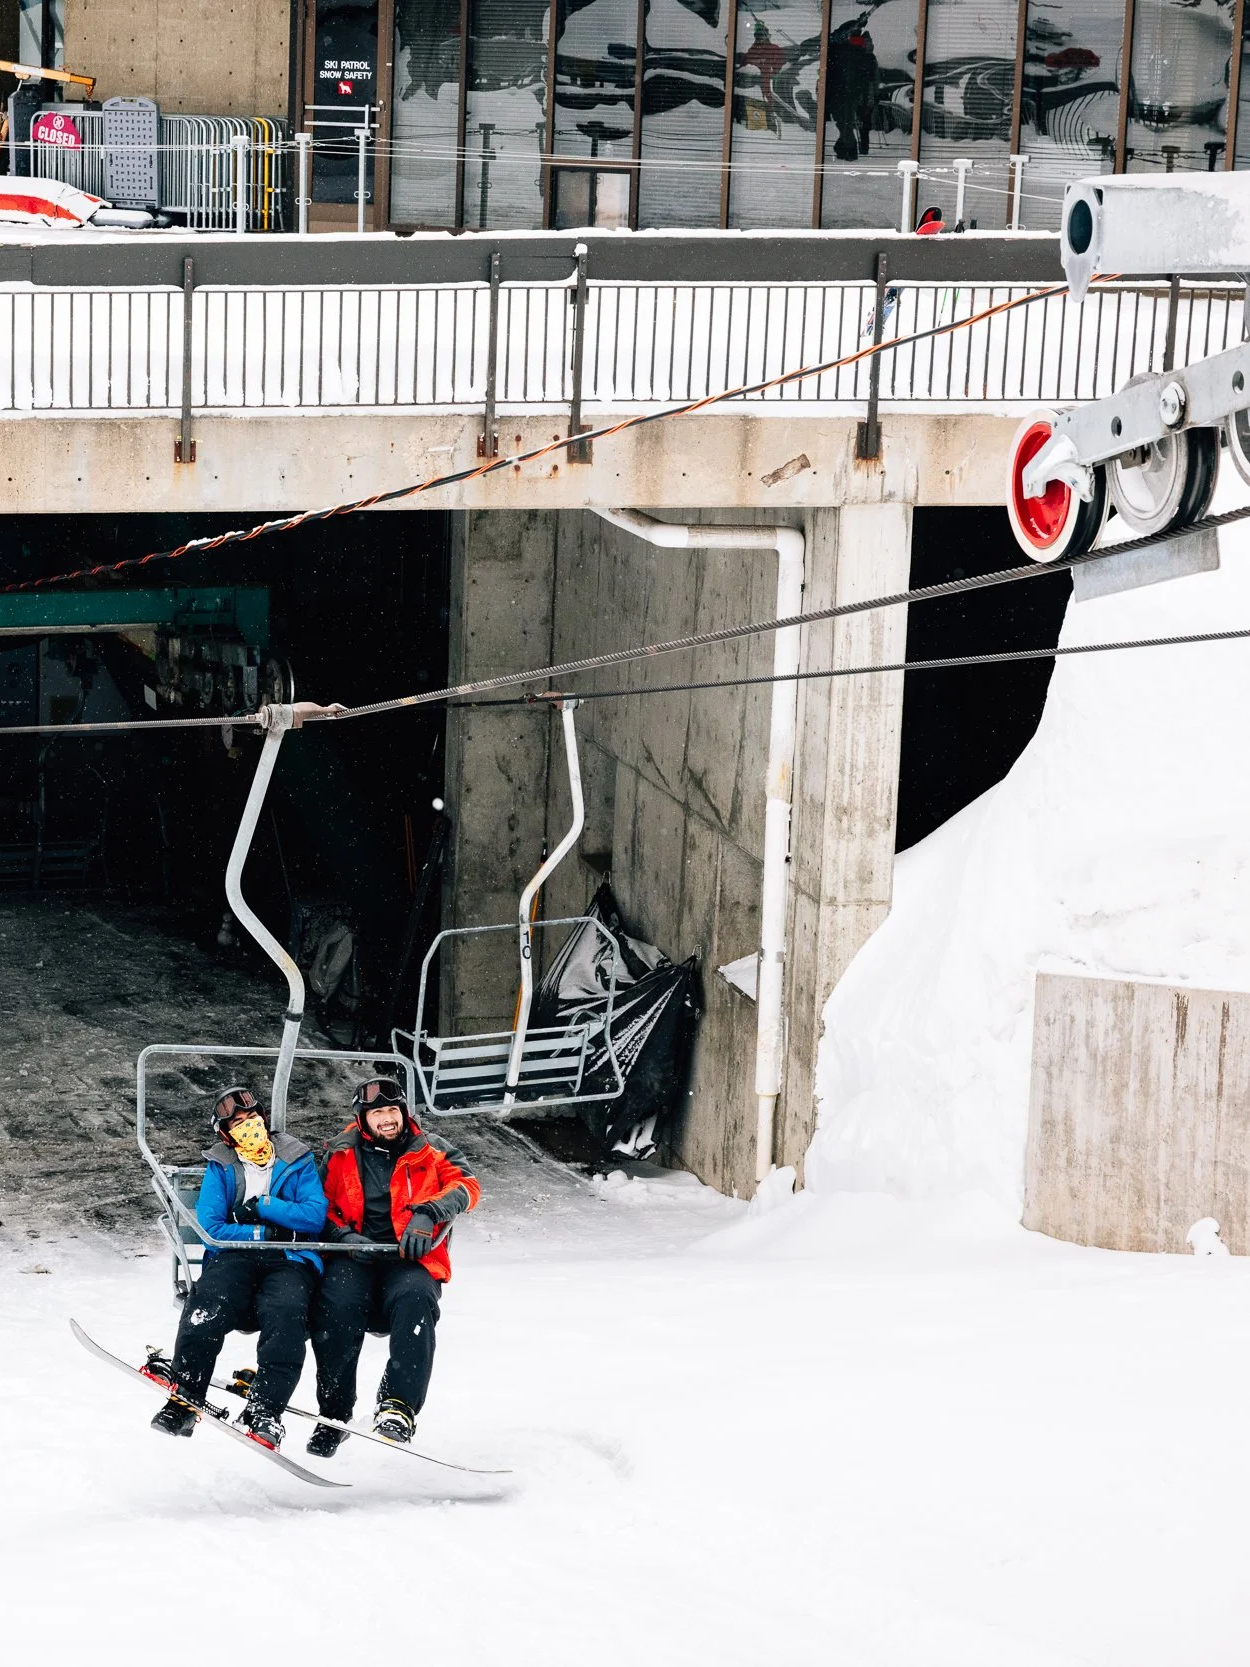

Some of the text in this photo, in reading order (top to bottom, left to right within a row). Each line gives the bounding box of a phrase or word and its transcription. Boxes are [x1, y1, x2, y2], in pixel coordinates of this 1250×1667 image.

[324, 60, 371, 70] SKI PATROL
[319, 70, 372, 80] SNOW SAFETY
[37, 125, 76, 147] CLOSED
